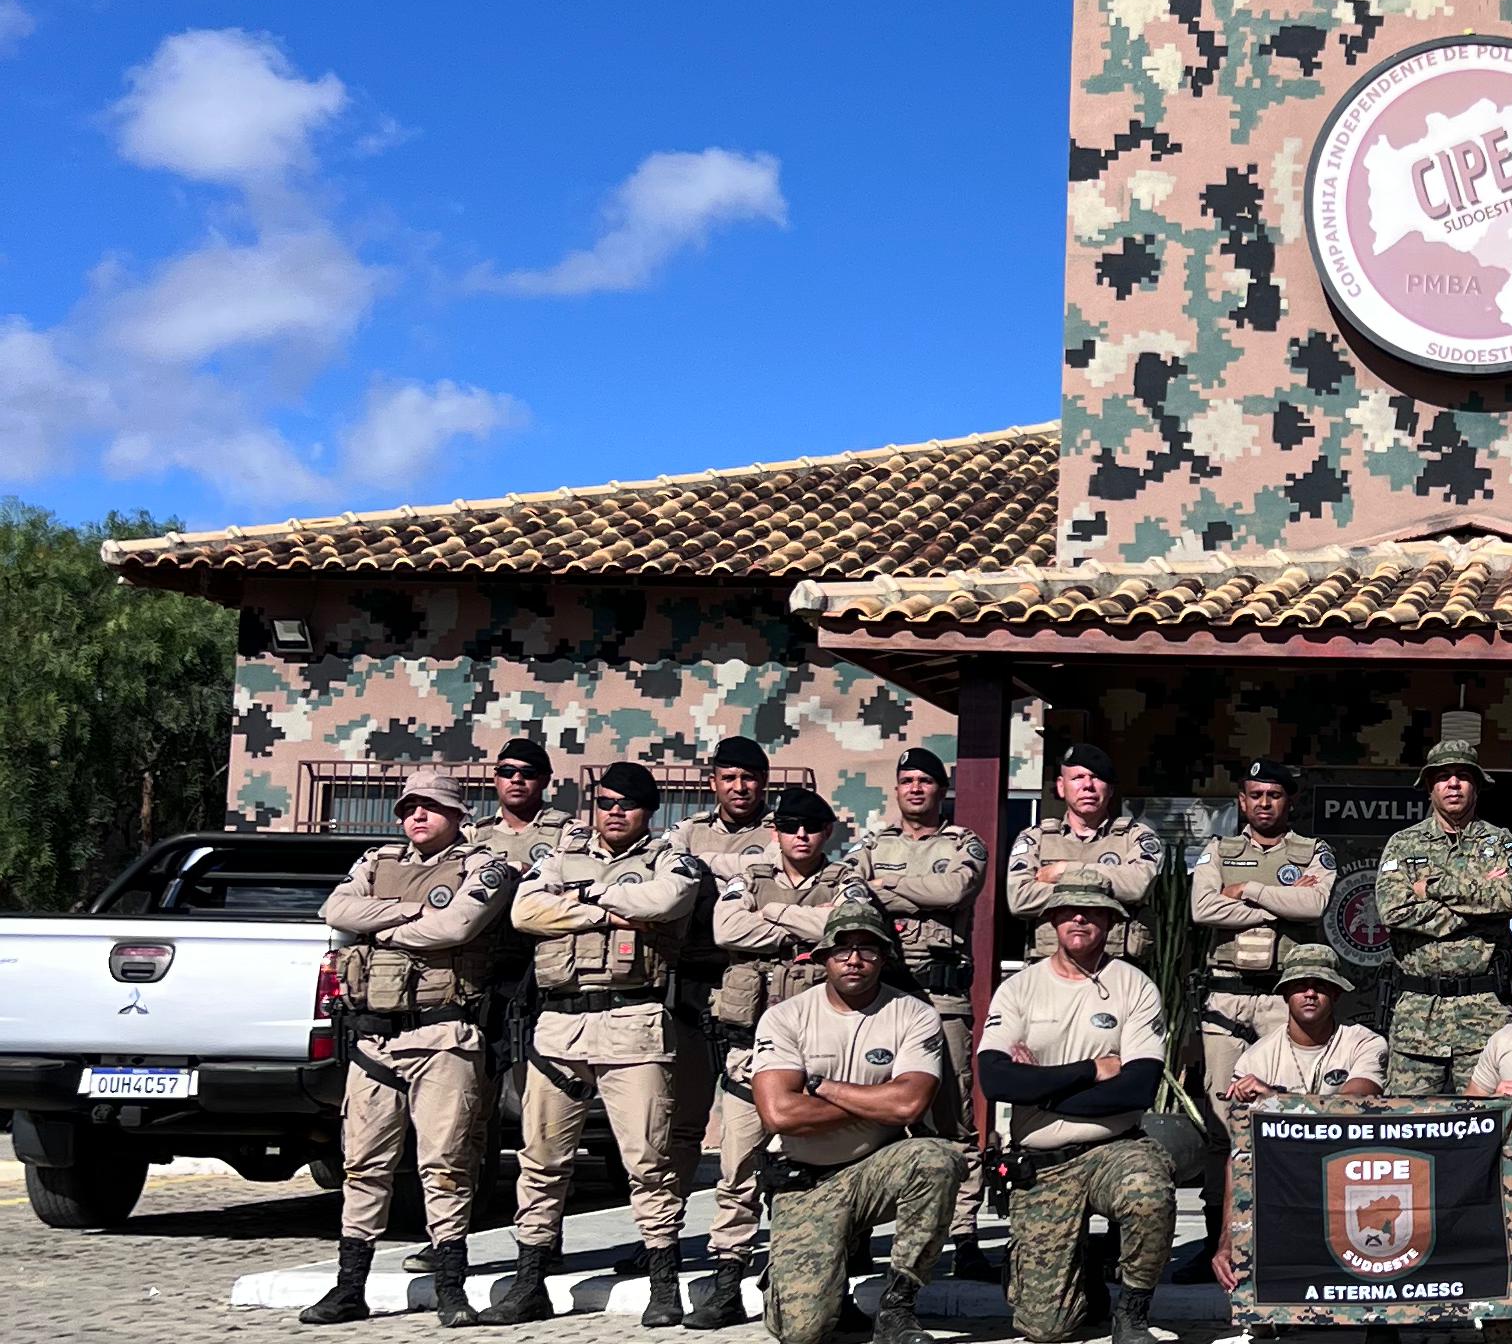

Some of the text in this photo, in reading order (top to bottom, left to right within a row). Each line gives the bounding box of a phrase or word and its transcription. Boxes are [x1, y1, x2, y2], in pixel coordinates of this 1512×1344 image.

[1443, 46, 1469, 62] DE
[1325, 52, 1438, 170] INDEPENDENTE
[1321, 176, 1362, 298] COMPANHIA
[1405, 273, 1483, 297] PMBA
[1261, 1117, 1495, 1141] NÚCLEO DE INSTRUÇÃO
[1345, 1159, 1410, 1181] CIPE
[1342, 1248, 1419, 1274] SUDOESTE
[1305, 1282, 1464, 1301] A ETERNA CAESG
